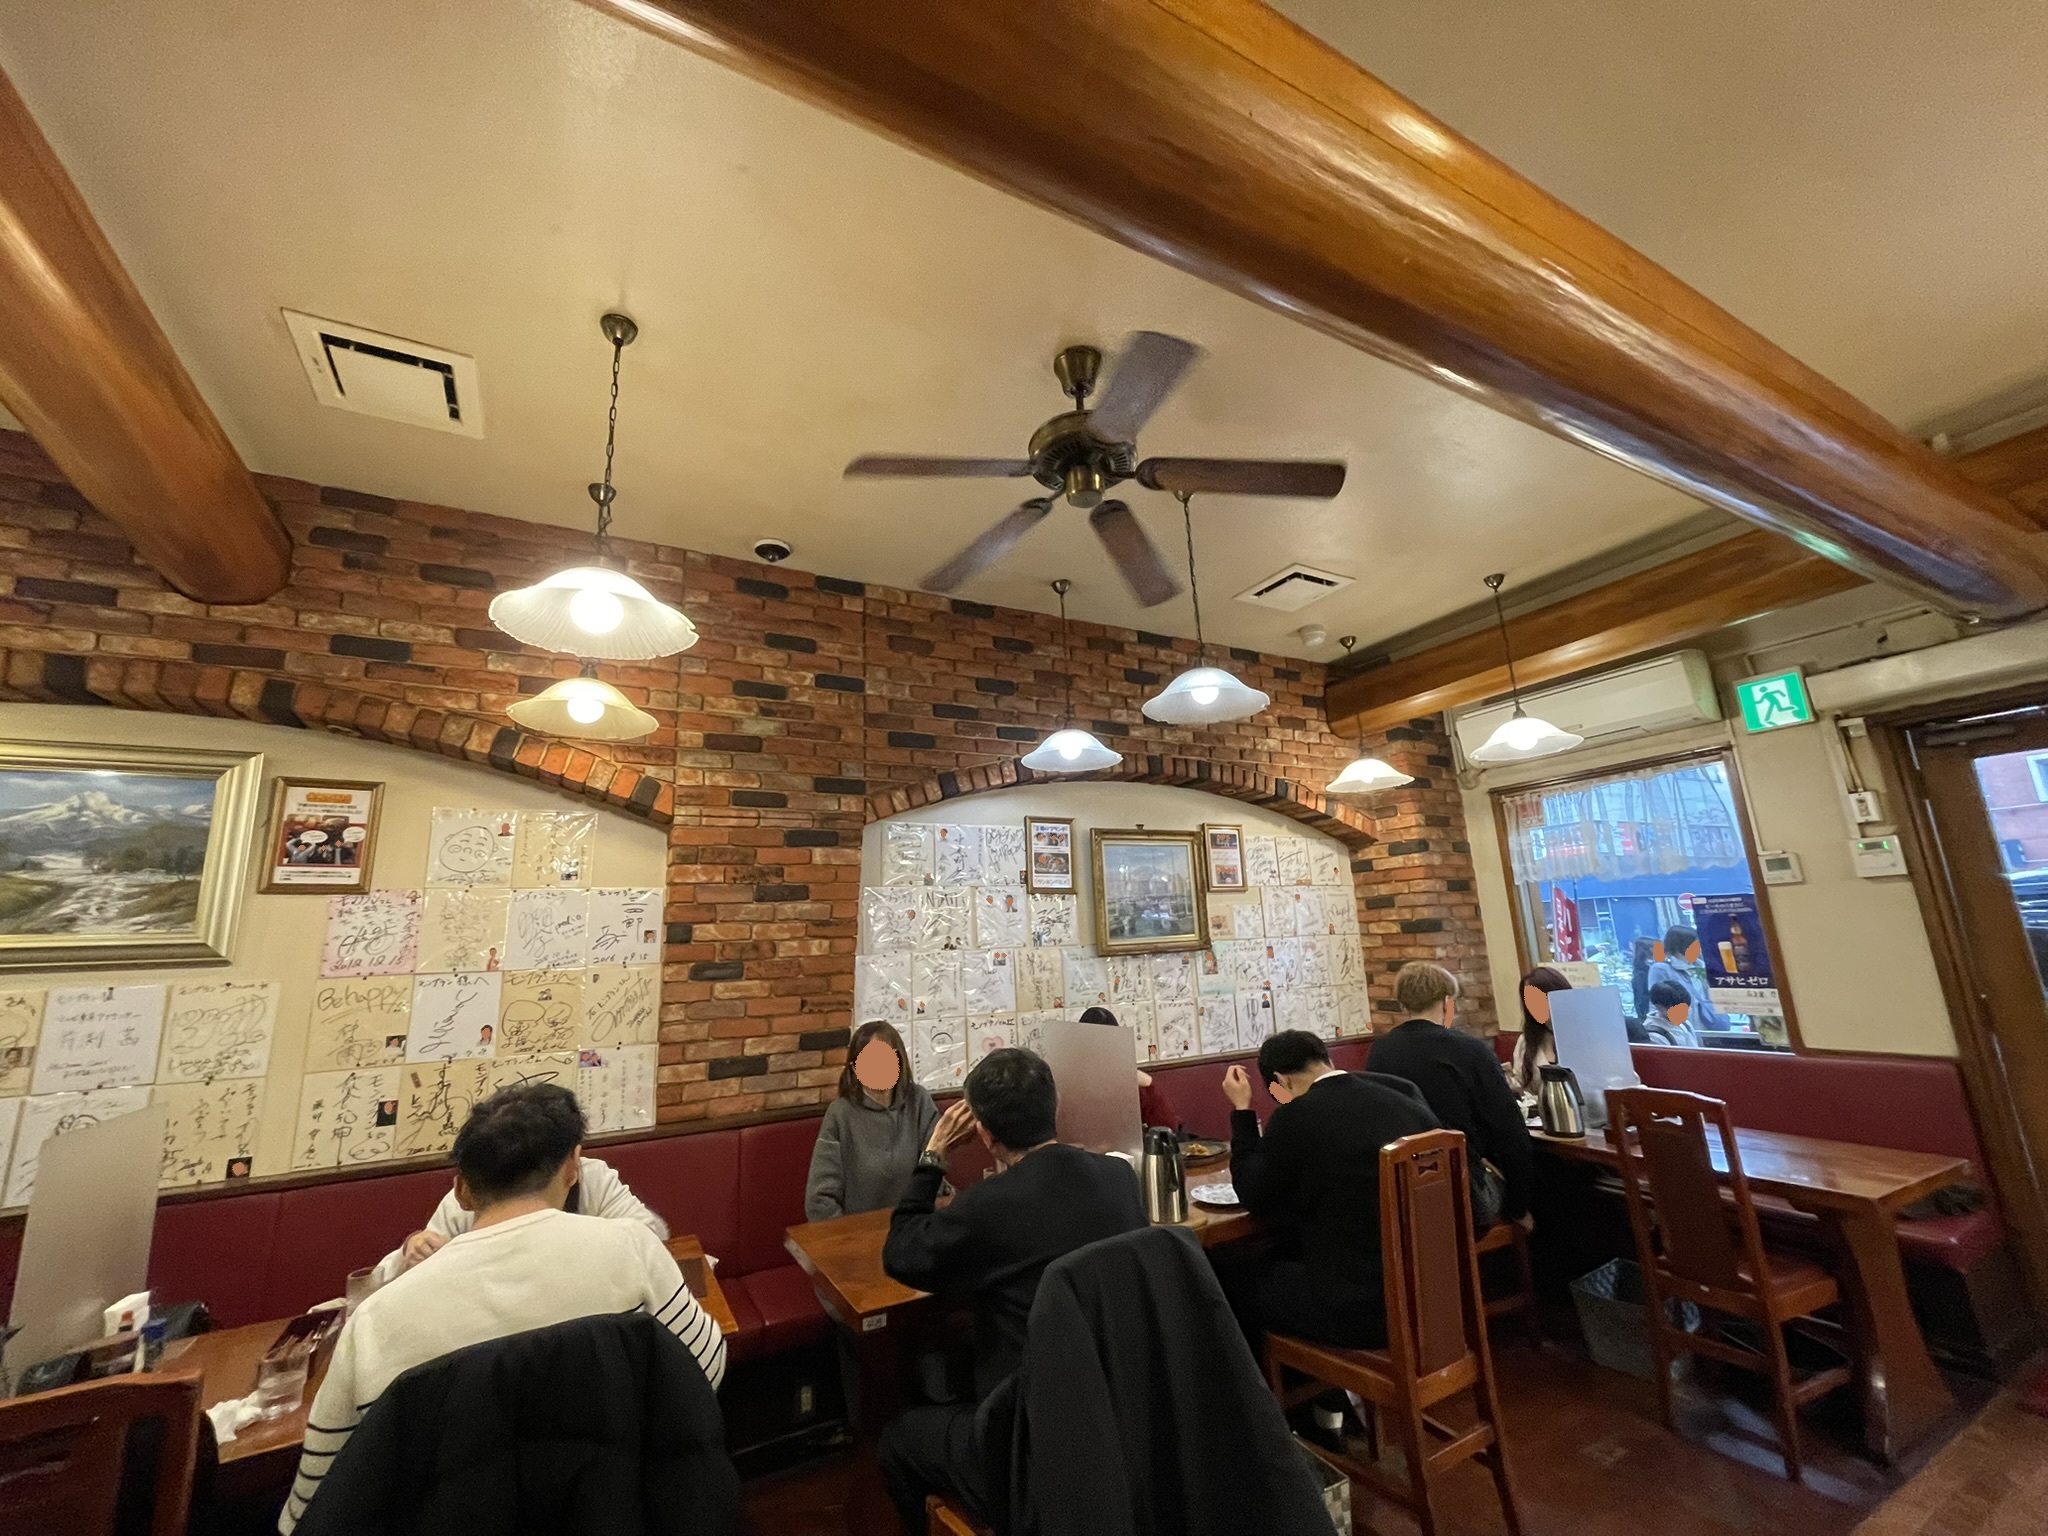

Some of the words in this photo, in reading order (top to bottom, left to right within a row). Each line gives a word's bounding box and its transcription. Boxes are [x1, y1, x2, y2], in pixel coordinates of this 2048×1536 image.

[593, 954, 616, 964] 2016
[1715, 976, 1768, 986] アサヒゼロ
